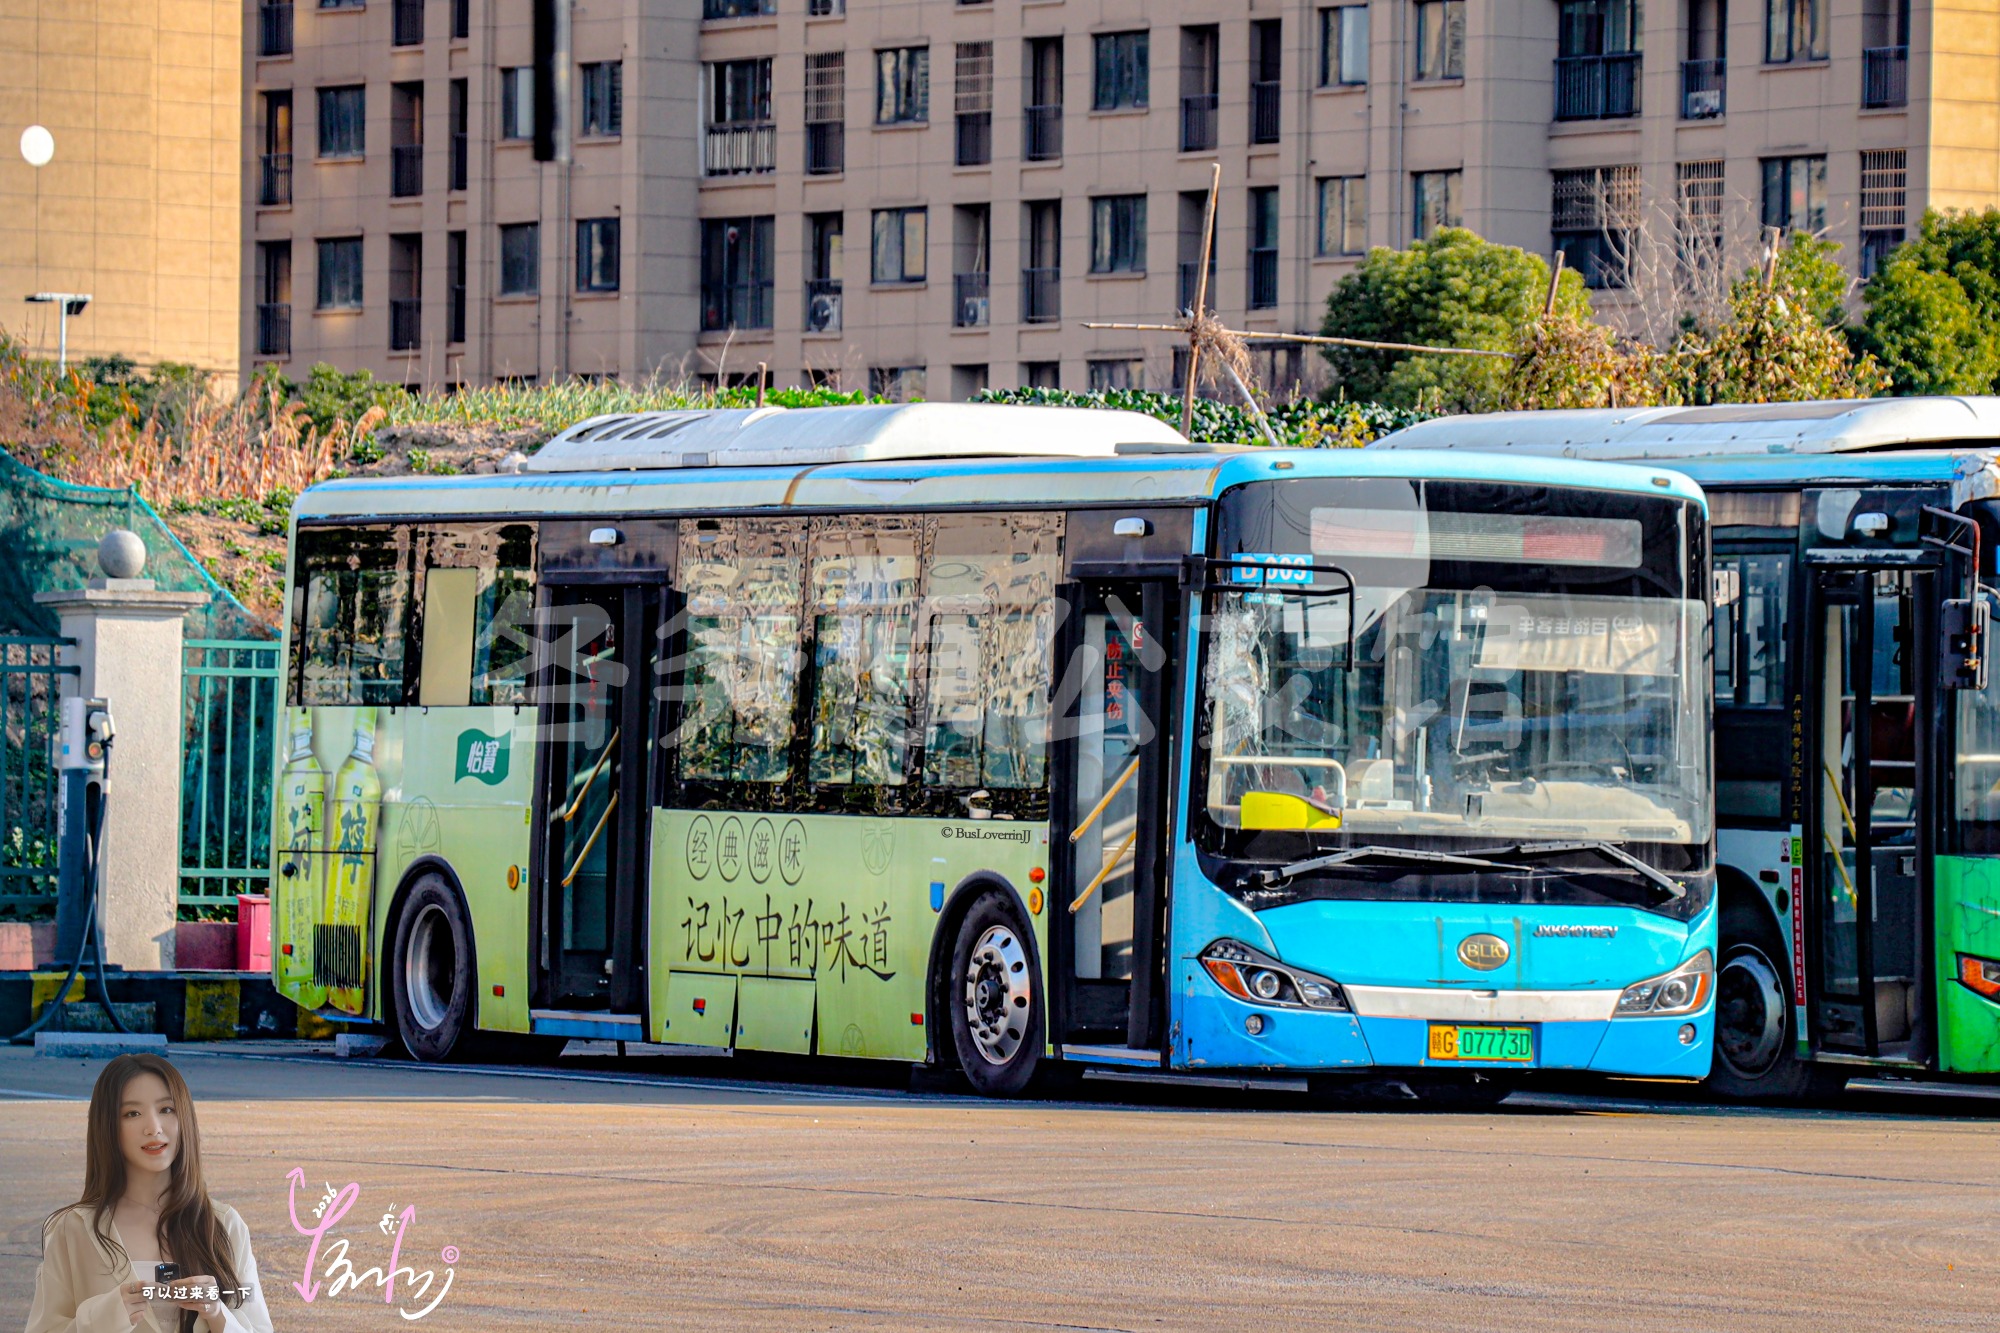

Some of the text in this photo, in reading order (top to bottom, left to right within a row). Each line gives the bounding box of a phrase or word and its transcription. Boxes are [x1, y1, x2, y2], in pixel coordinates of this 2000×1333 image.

[690, 829, 802, 871] 经典滋味
[681, 893, 897, 984] 记忆中的味道
[1467, 944, 1506, 958] BLK
[1463, 1031, 1530, 1056] 07773D
